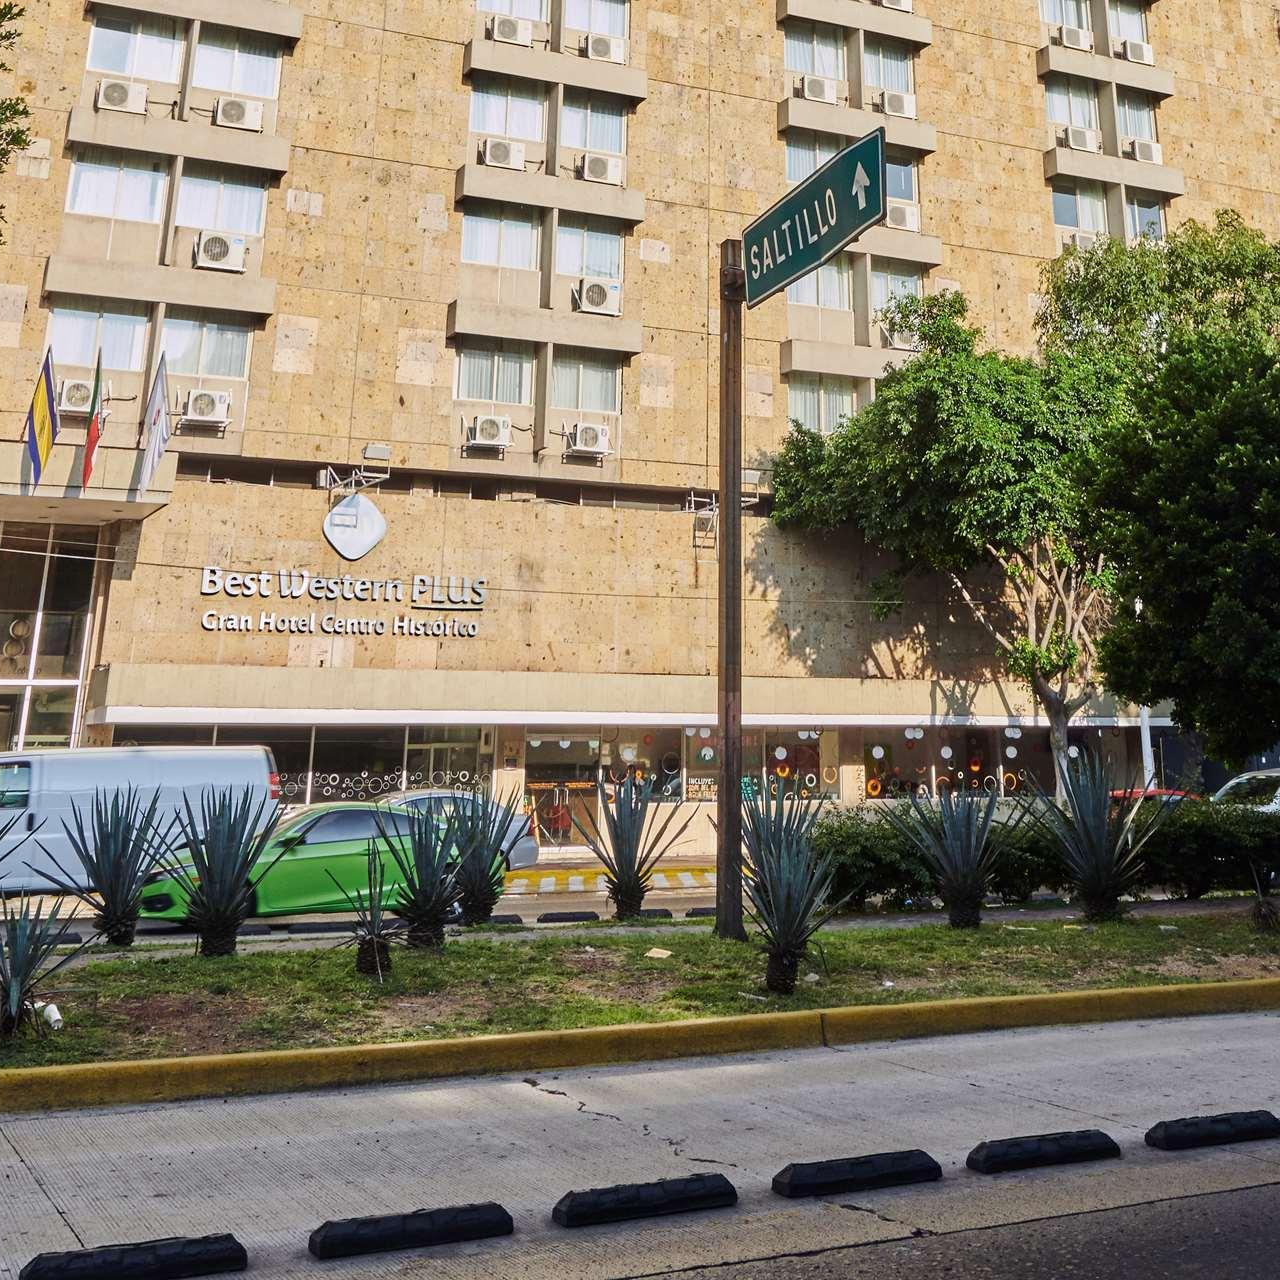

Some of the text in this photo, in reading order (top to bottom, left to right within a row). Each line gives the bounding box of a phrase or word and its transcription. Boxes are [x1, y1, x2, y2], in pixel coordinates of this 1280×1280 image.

[750, 188, 837, 280] SALTILLO
[201, 566, 487, 604] Best Western PLUS
[201, 610, 479, 638] Gran Hotel Centro Histórico
